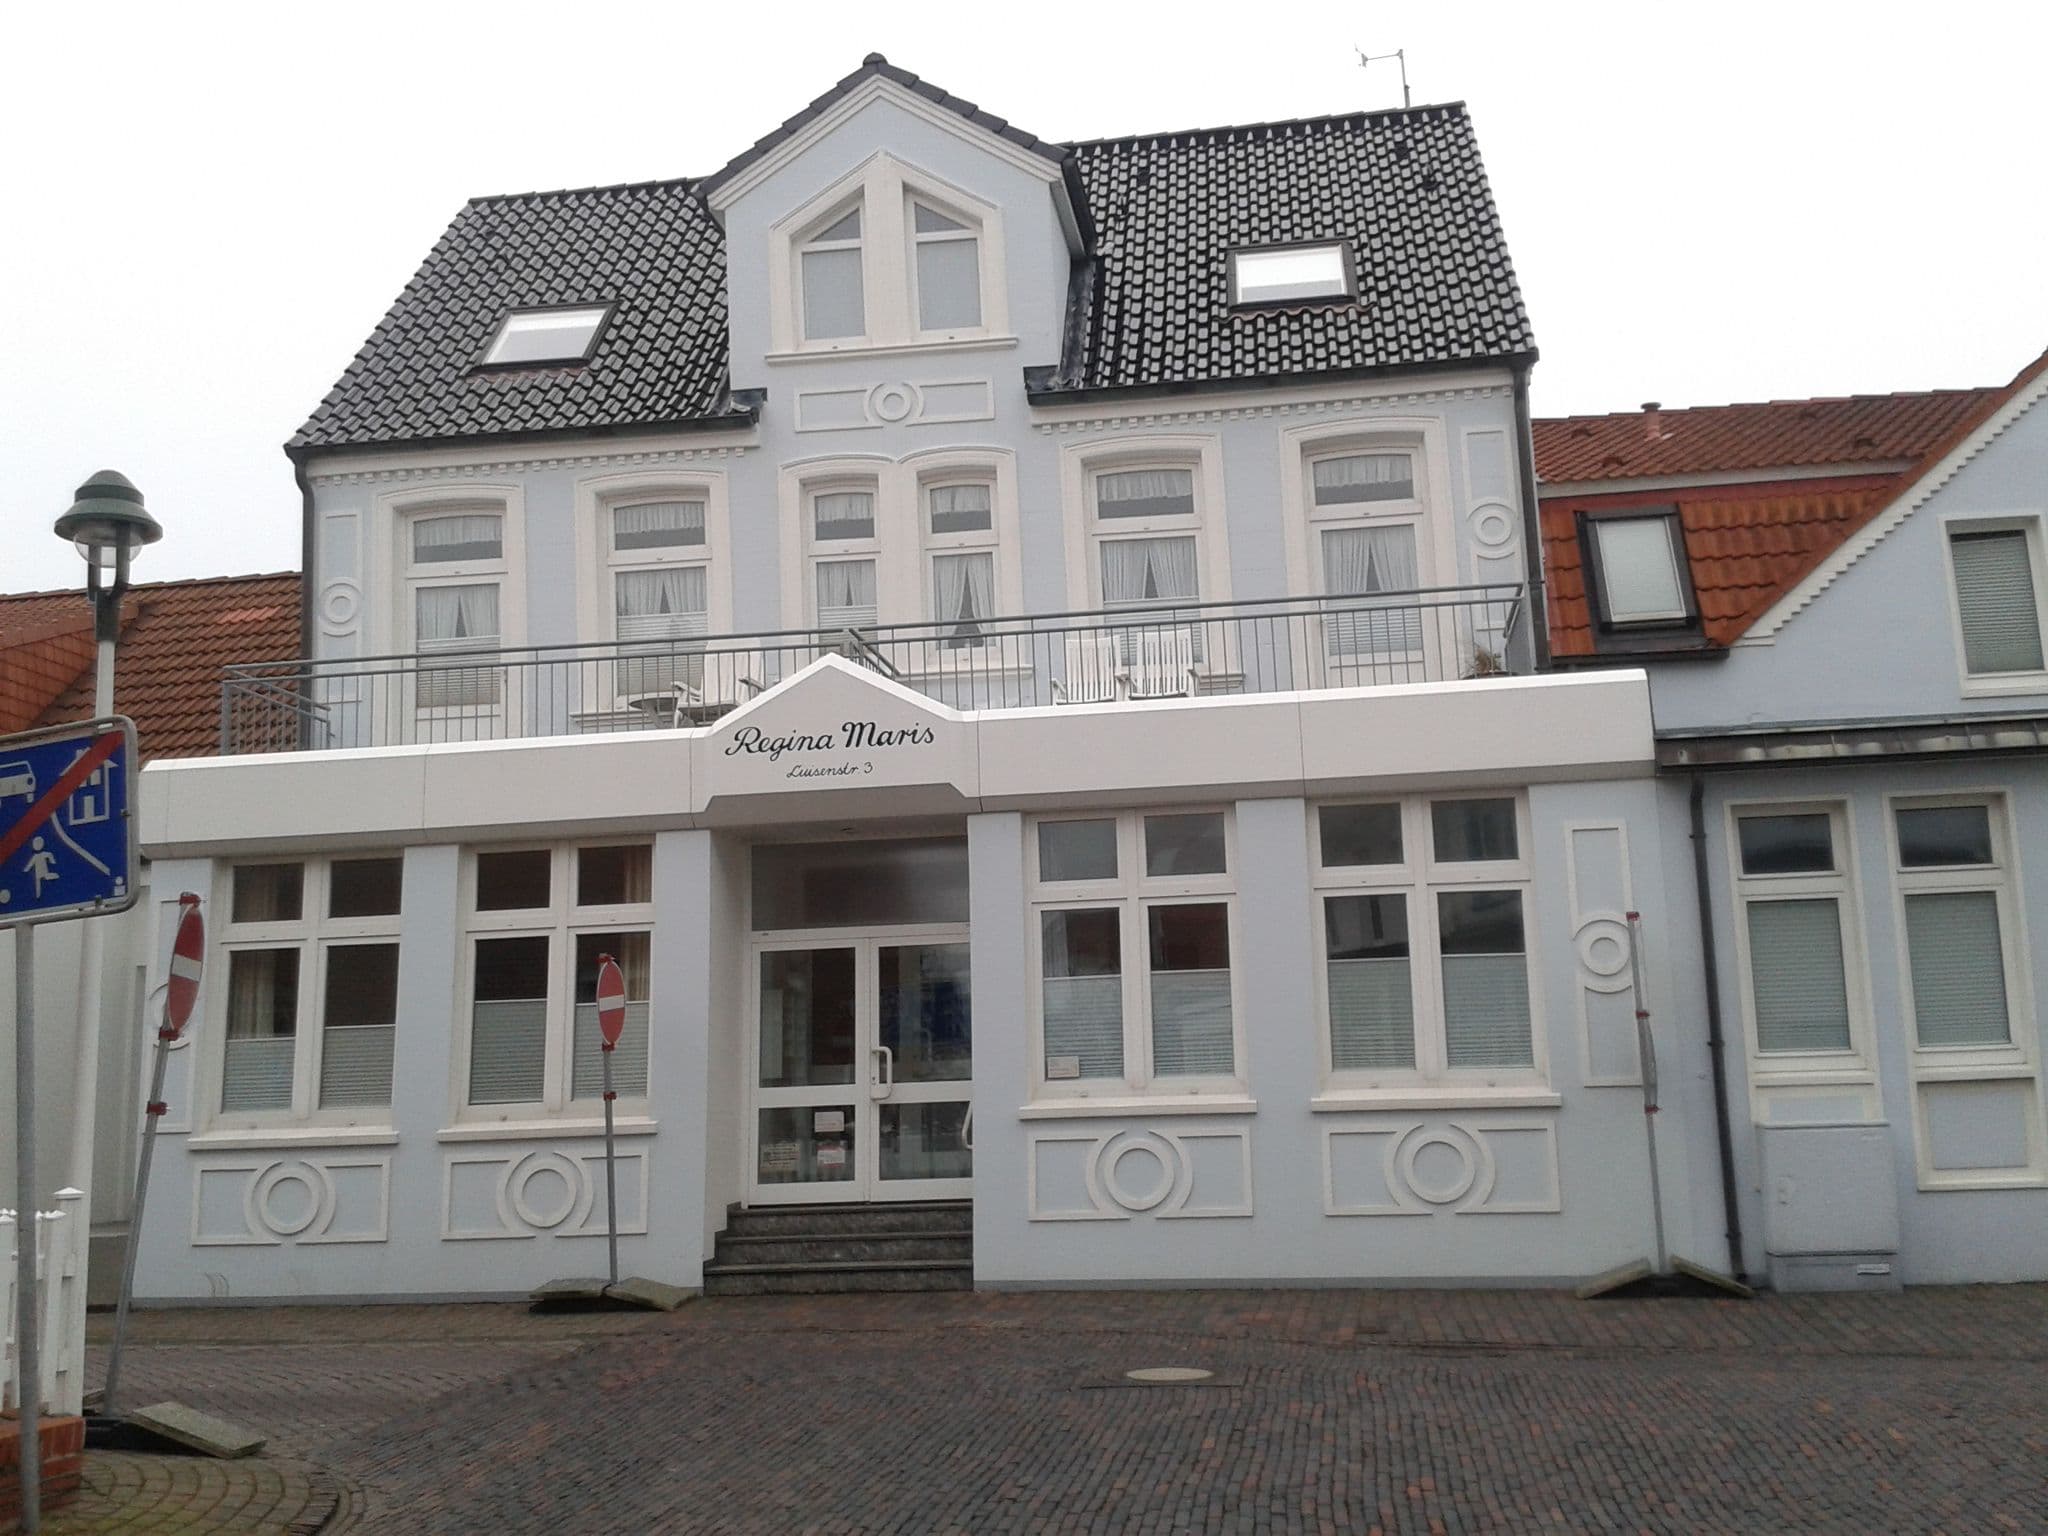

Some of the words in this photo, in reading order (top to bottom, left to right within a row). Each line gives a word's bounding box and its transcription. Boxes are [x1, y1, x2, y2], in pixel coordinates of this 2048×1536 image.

[724, 726, 835, 762] Regina
[841, 721, 935, 748] Maris
[864, 761, 873, 774] 3
